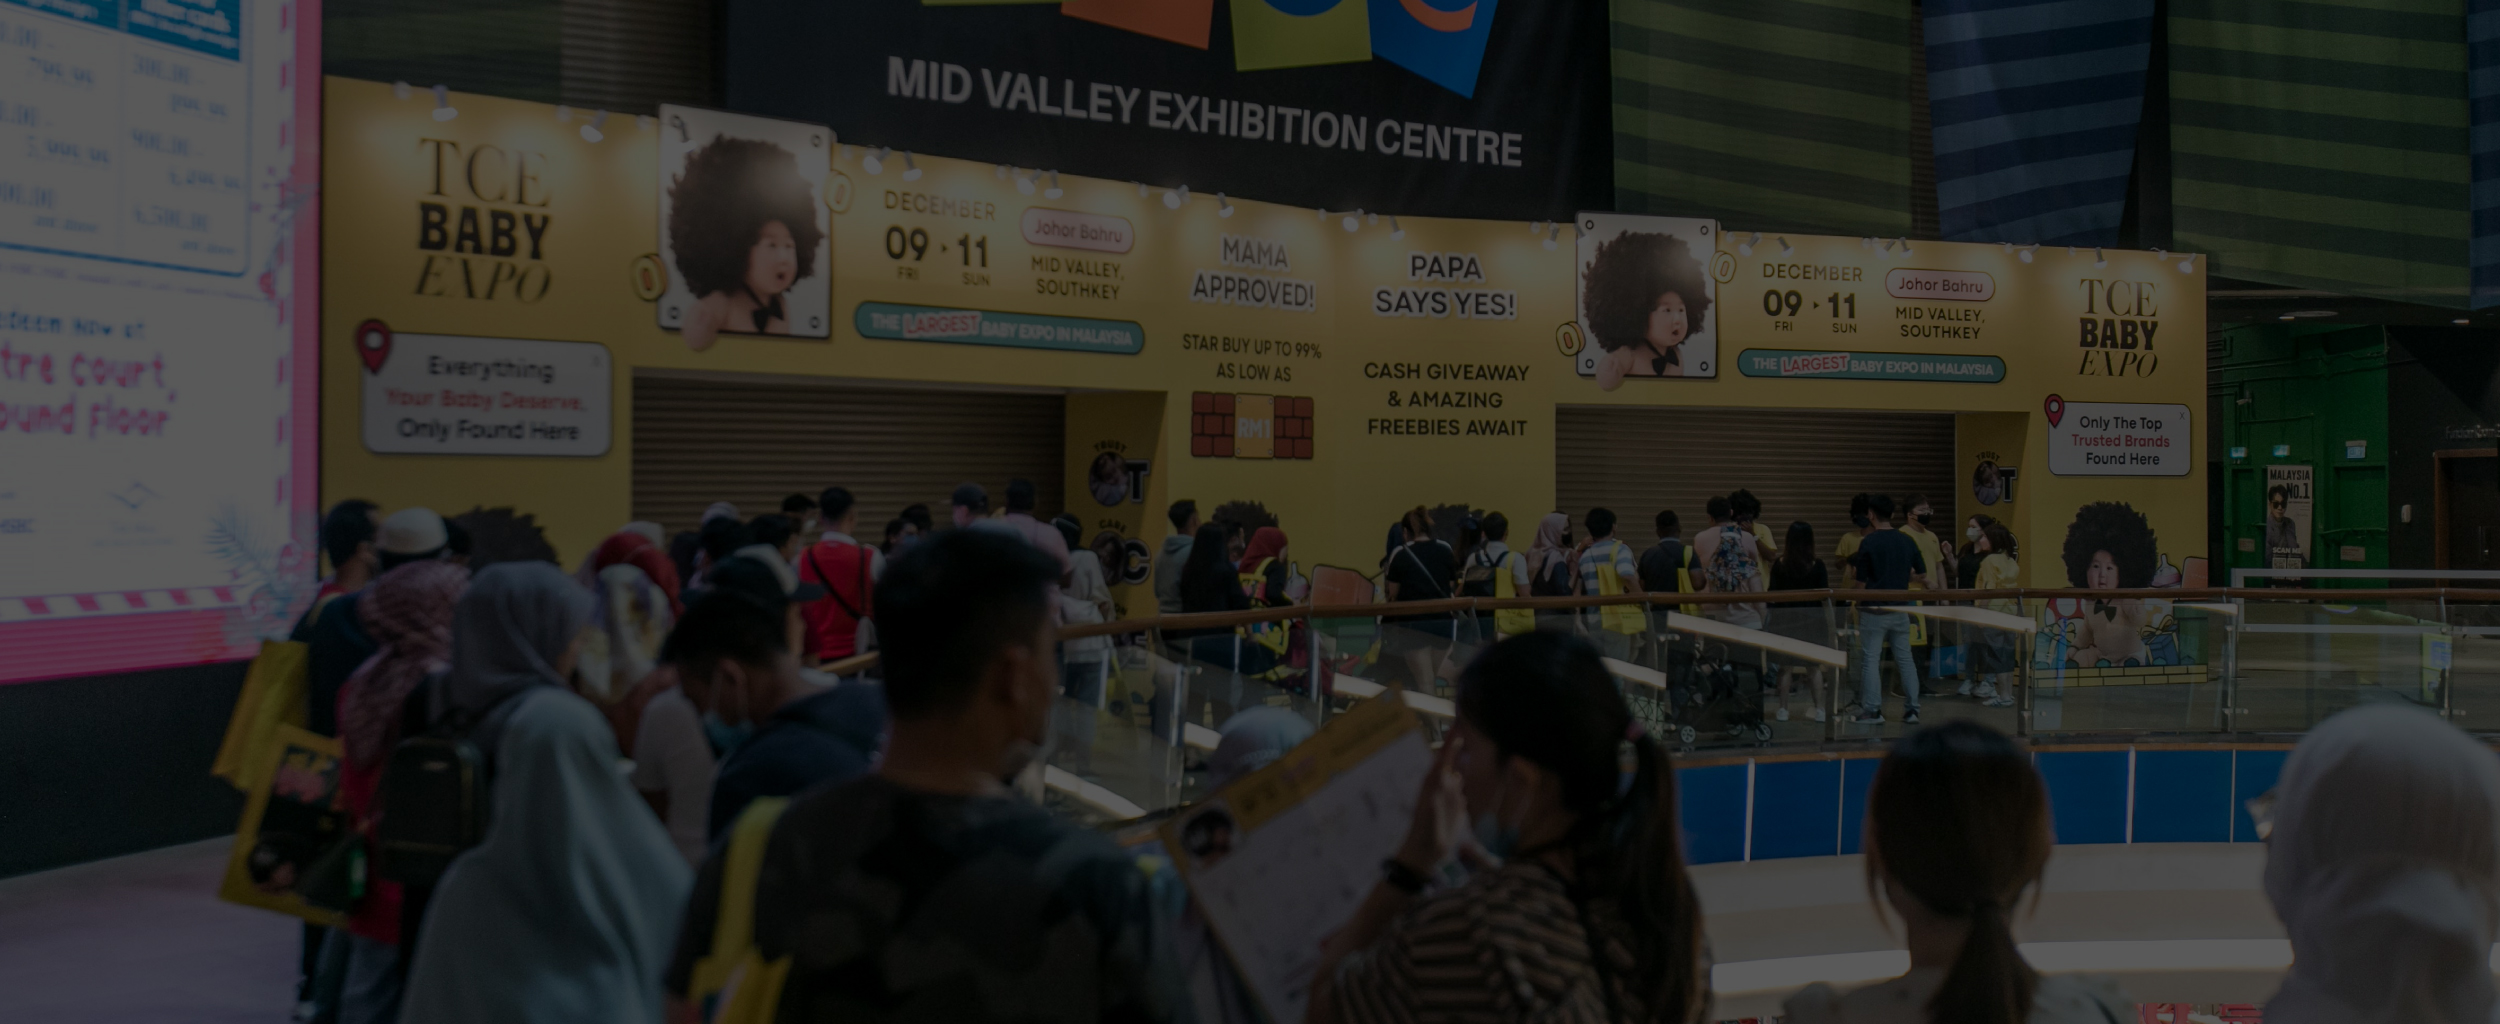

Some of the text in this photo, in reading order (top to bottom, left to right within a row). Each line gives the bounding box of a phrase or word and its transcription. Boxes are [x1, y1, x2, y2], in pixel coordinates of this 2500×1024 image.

[886, 56, 1523, 168] MID VALLEY EXHIBITION CENTRE
[420, 137, 549, 208] TCE
[885, 190, 996, 221] DECEMBER
[419, 201, 549, 260] BABY
[1035, 218, 1123, 243] Johor Bahru
[886, 225, 989, 268] 09 11
[1222, 236, 1289, 268] MAMA
[897, 266, 919, 281] FRI
[1031, 255, 1125, 281] MID VALLEY,
[1411, 254, 1483, 280] PAPA
[1763, 263, 1863, 282] DECEMBER
[414, 254, 552, 304] EXPO
[962, 271, 990, 286] SUN
[1036, 278, 1120, 299] SOUTHKEY
[1899, 277, 1983, 293] Johor Bahru
[1193, 273, 1315, 308] APPROVED!
[2079, 278, 2158, 317] TCE
[1376, 290, 1515, 316] SAYS YES!
[1763, 289, 1856, 319] 09 11
[1896, 306, 1986, 324] MID VALLEY,
[871, 312, 1133, 346] THE LARGEST BABY EXPO IN MALAYSIA
[1775, 320, 1793, 332] FRI
[1832, 322, 1857, 334] SUN
[1900, 324, 1981, 339] SOUTHKEY
[2079, 317, 2158, 350] BABY
[1183, 333, 1322, 359] STAR BUY UP TO 99%
[429, 356, 554, 383] Everything
[1216, 362, 1291, 382] AS LOW AS
[1364, 362, 1530, 381] CASH GIVEAWAY
[1752, 355, 1994, 376] THE LARGEST BABY EXPO IN MALAYSIA
[2077, 350, 2158, 378] EXPO
[385, 388, 433, 407] Your
[441, 389, 492, 411] Baby
[1388, 391, 1503, 408] & AMAZING
[398, 417, 579, 442] Only Found Here
[1237, 416, 1271, 438] RM1
[1368, 418, 1528, 436] FREEBIES AWAIT
[2079, 416, 2162, 433] Only The Top
[1094, 439, 1127, 452] TRUST
[2071, 434, 2170, 448] Trusted Brands
[1976, 451, 2001, 462] TRUST
[2086, 452, 2160, 465] Found Here
[2269, 469, 2310, 481] MALAYSIA
[1099, 519, 1127, 533] CARE
[2272, 546, 2291, 554] SCAN
